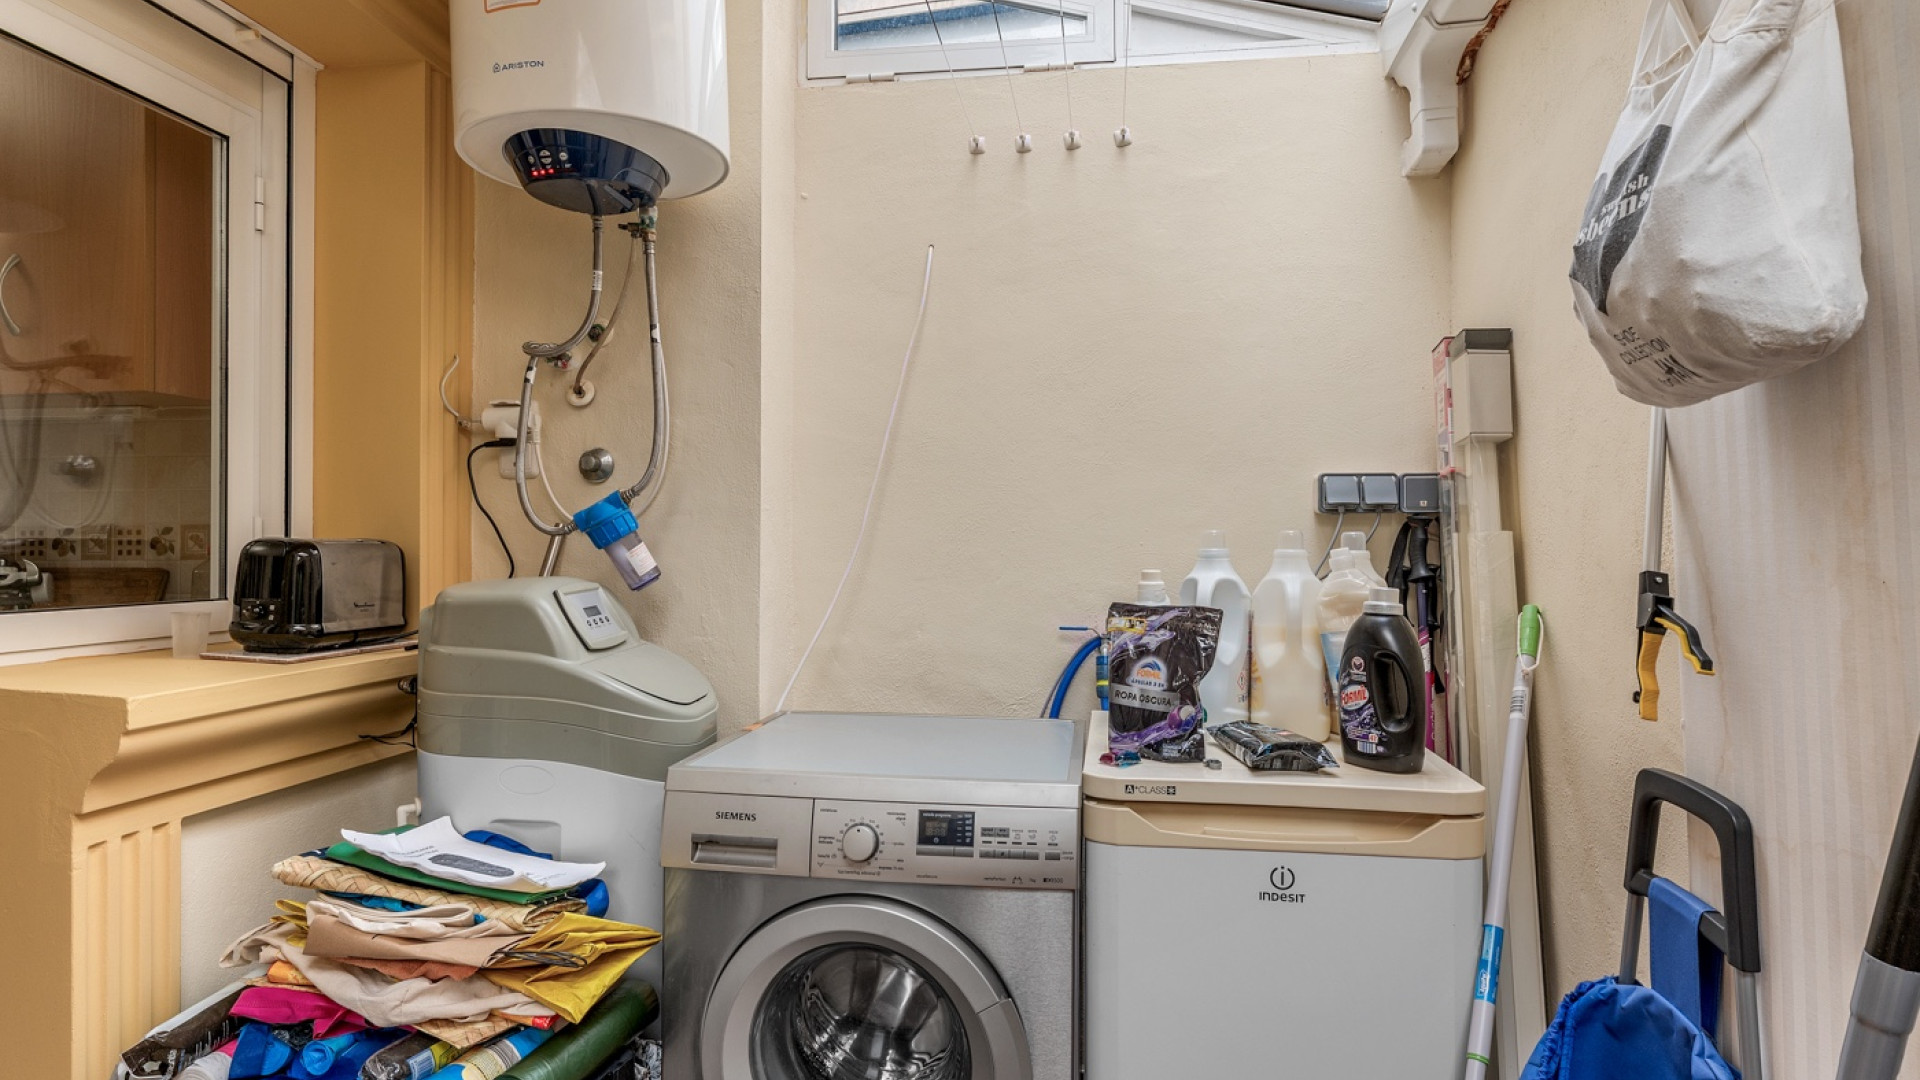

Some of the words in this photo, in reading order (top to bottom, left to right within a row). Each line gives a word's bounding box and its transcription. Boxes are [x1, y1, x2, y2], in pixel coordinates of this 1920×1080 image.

[502, 60, 544, 71] ARISTON
[1114, 689, 1137, 702] ROPA
[1139, 694, 1171, 707] OSCURA
[715, 811, 757, 822] SIEMENS
